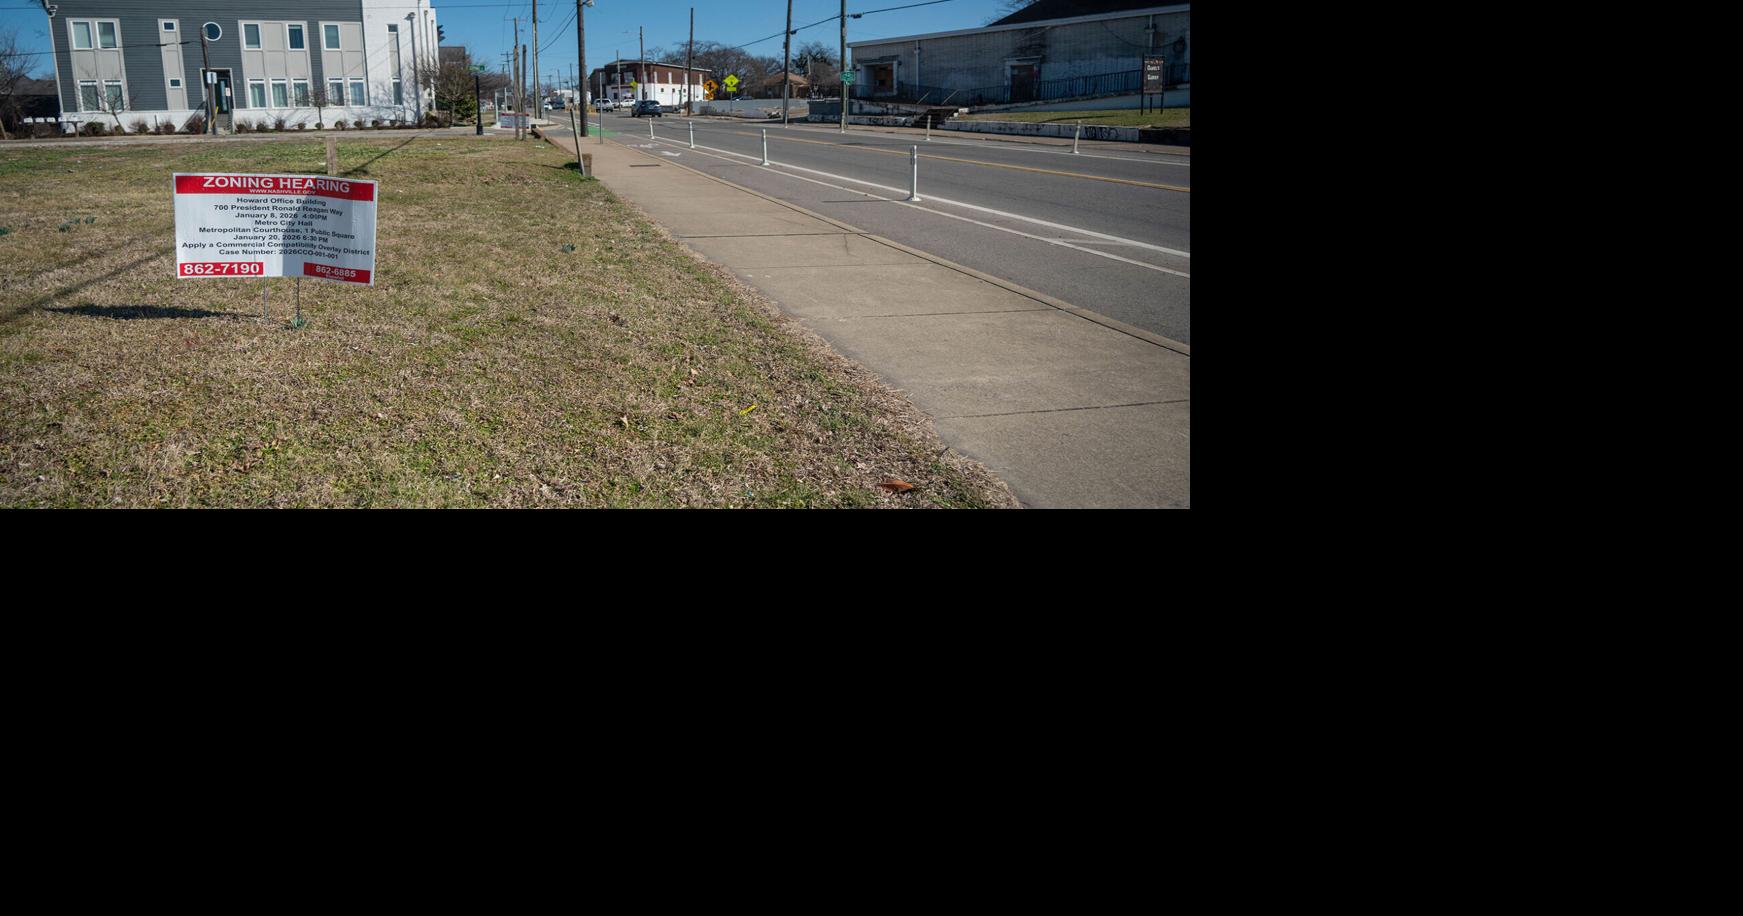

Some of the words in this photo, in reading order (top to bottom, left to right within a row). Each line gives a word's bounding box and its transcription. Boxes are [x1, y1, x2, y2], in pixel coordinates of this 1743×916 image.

[203, 177, 273, 188] ZONING
[280, 178, 349, 192] HEARING
[296, 198, 326, 206] Building
[330, 208, 343, 216] Way
[311, 228, 330, 236] Public
[332, 231, 355, 240] Square
[279, 249, 338, 259] 2026CCO-001-001
[318, 244, 341, 253] Overlay
[343, 247, 370, 255] District
[184, 263, 259, 274] 862-7190
[315, 265, 356, 277] 862-6885
